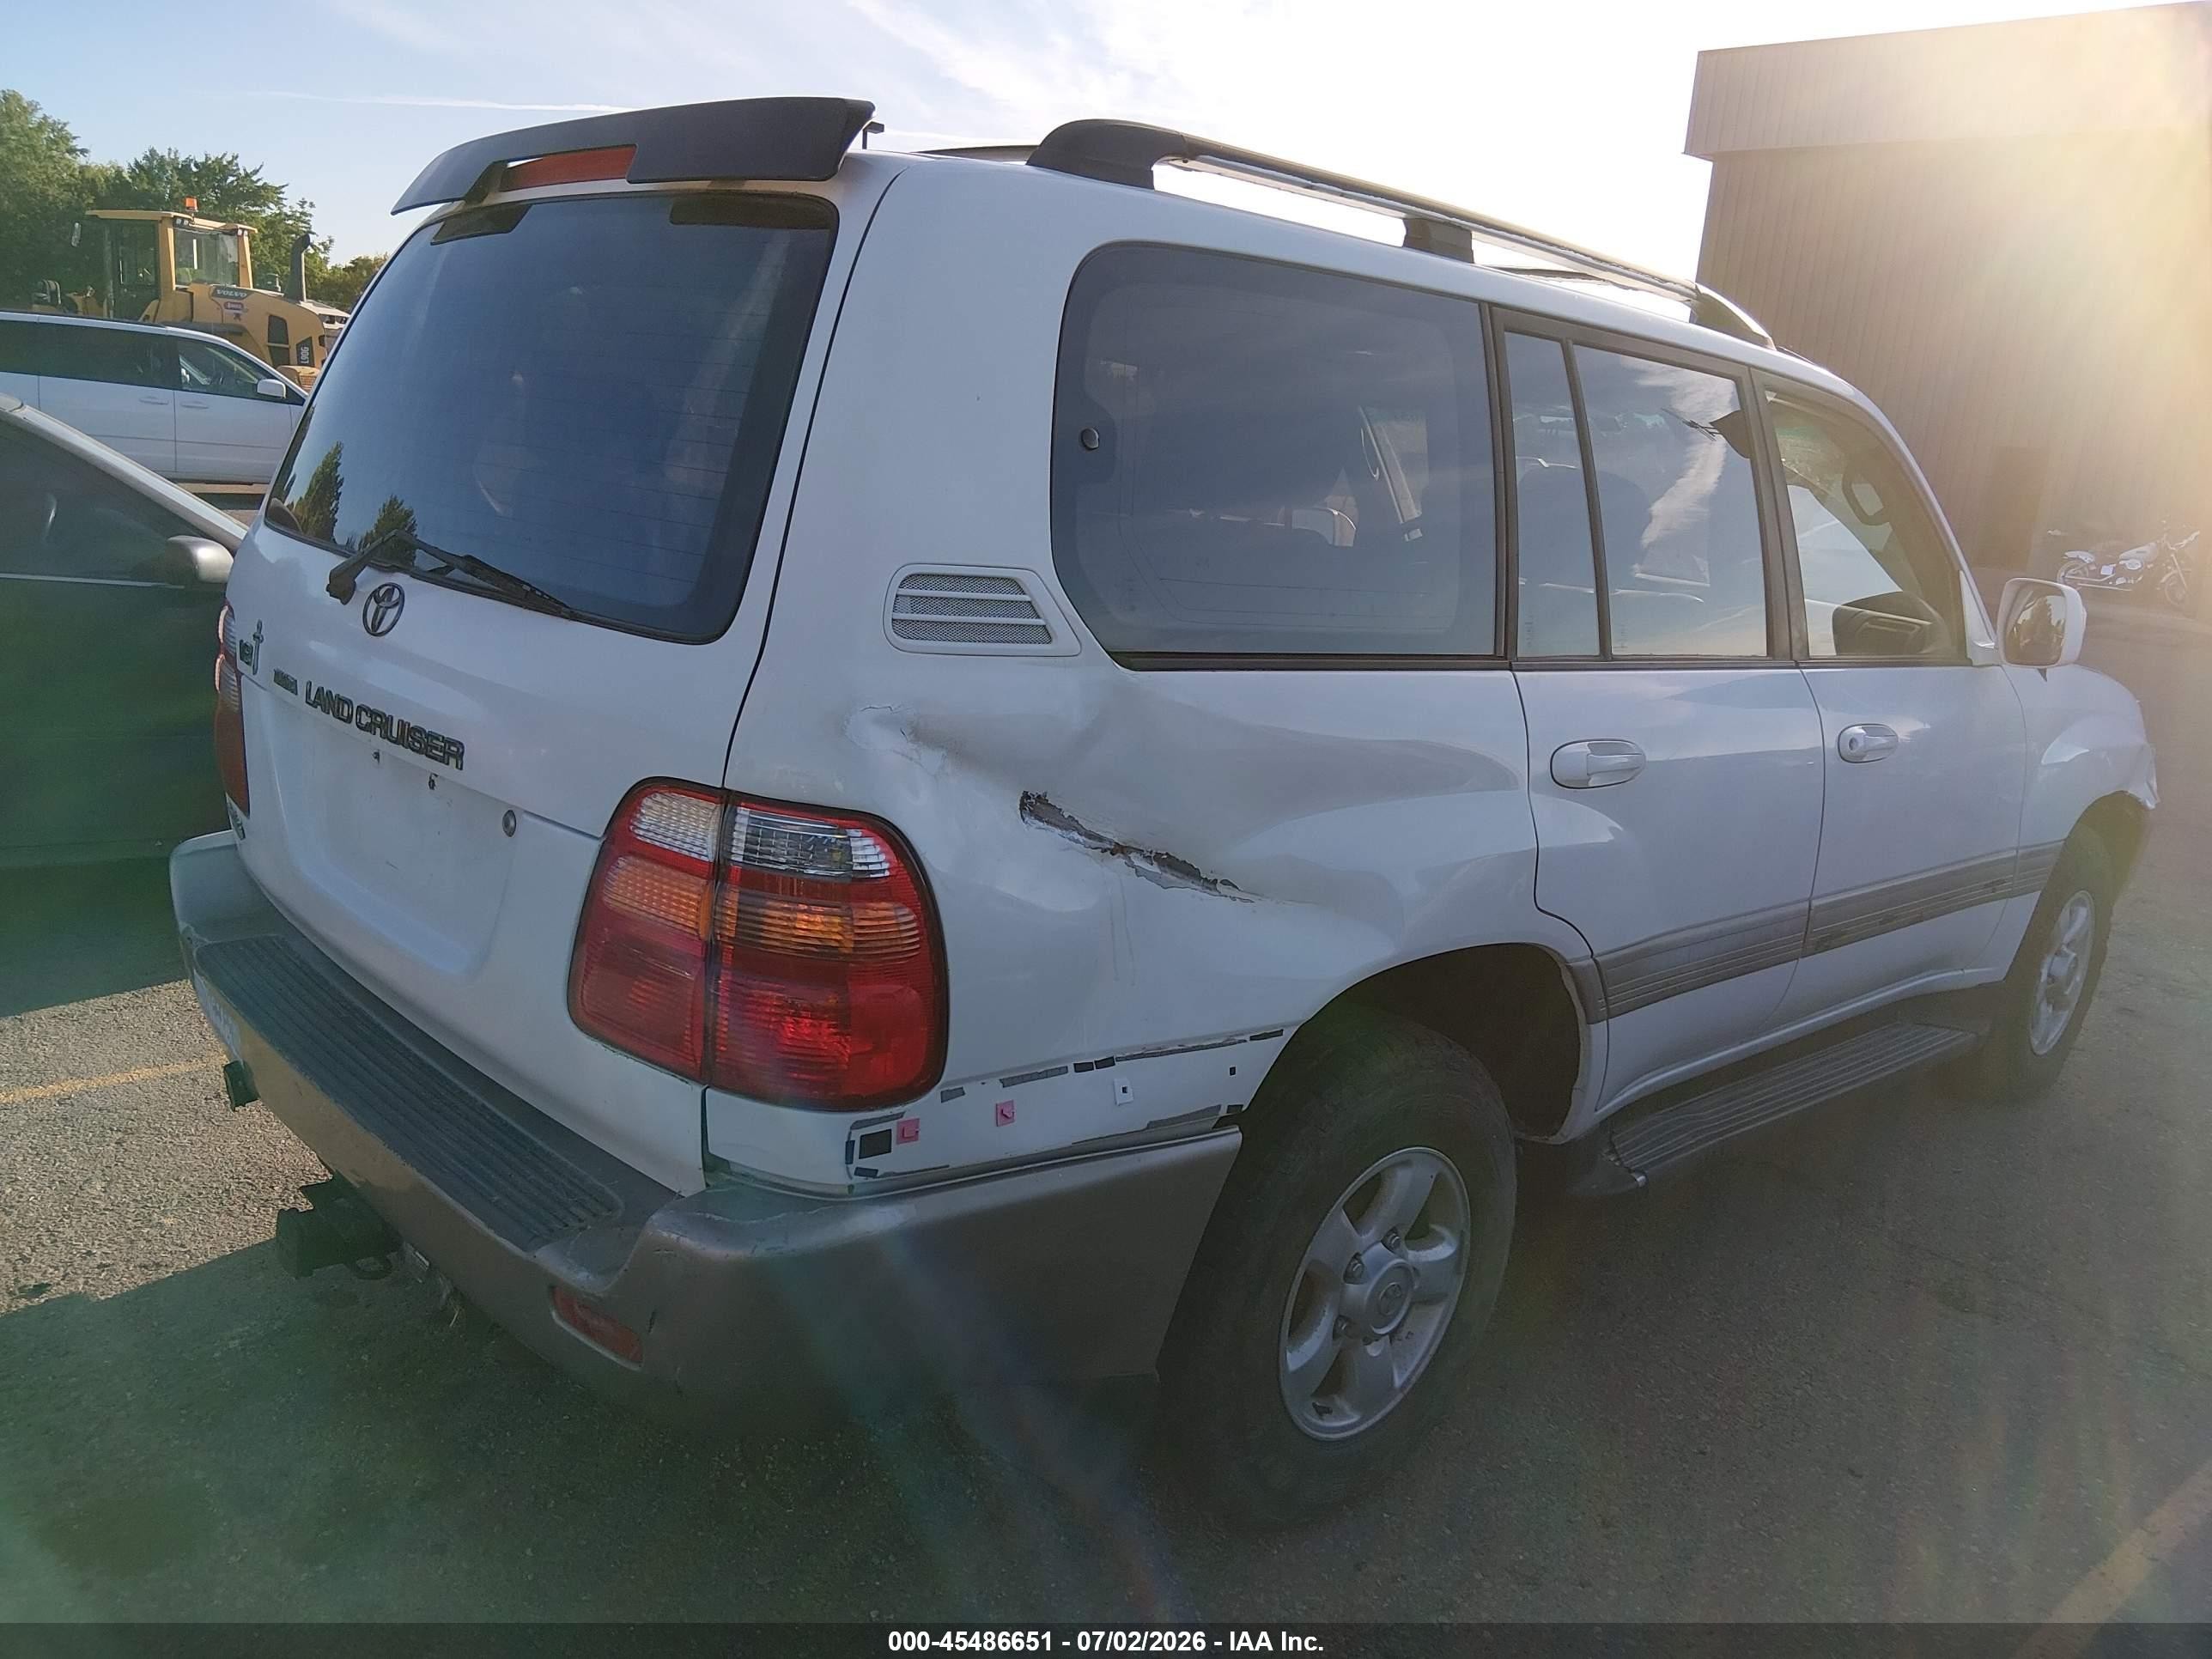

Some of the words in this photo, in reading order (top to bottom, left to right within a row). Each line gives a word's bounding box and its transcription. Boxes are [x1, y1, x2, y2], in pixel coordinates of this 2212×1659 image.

[216, 289, 248, 298] VOLVO
[301, 346, 310, 364] L90G
[305, 680, 354, 725] LAND
[356, 703, 465, 770] CRUISER
